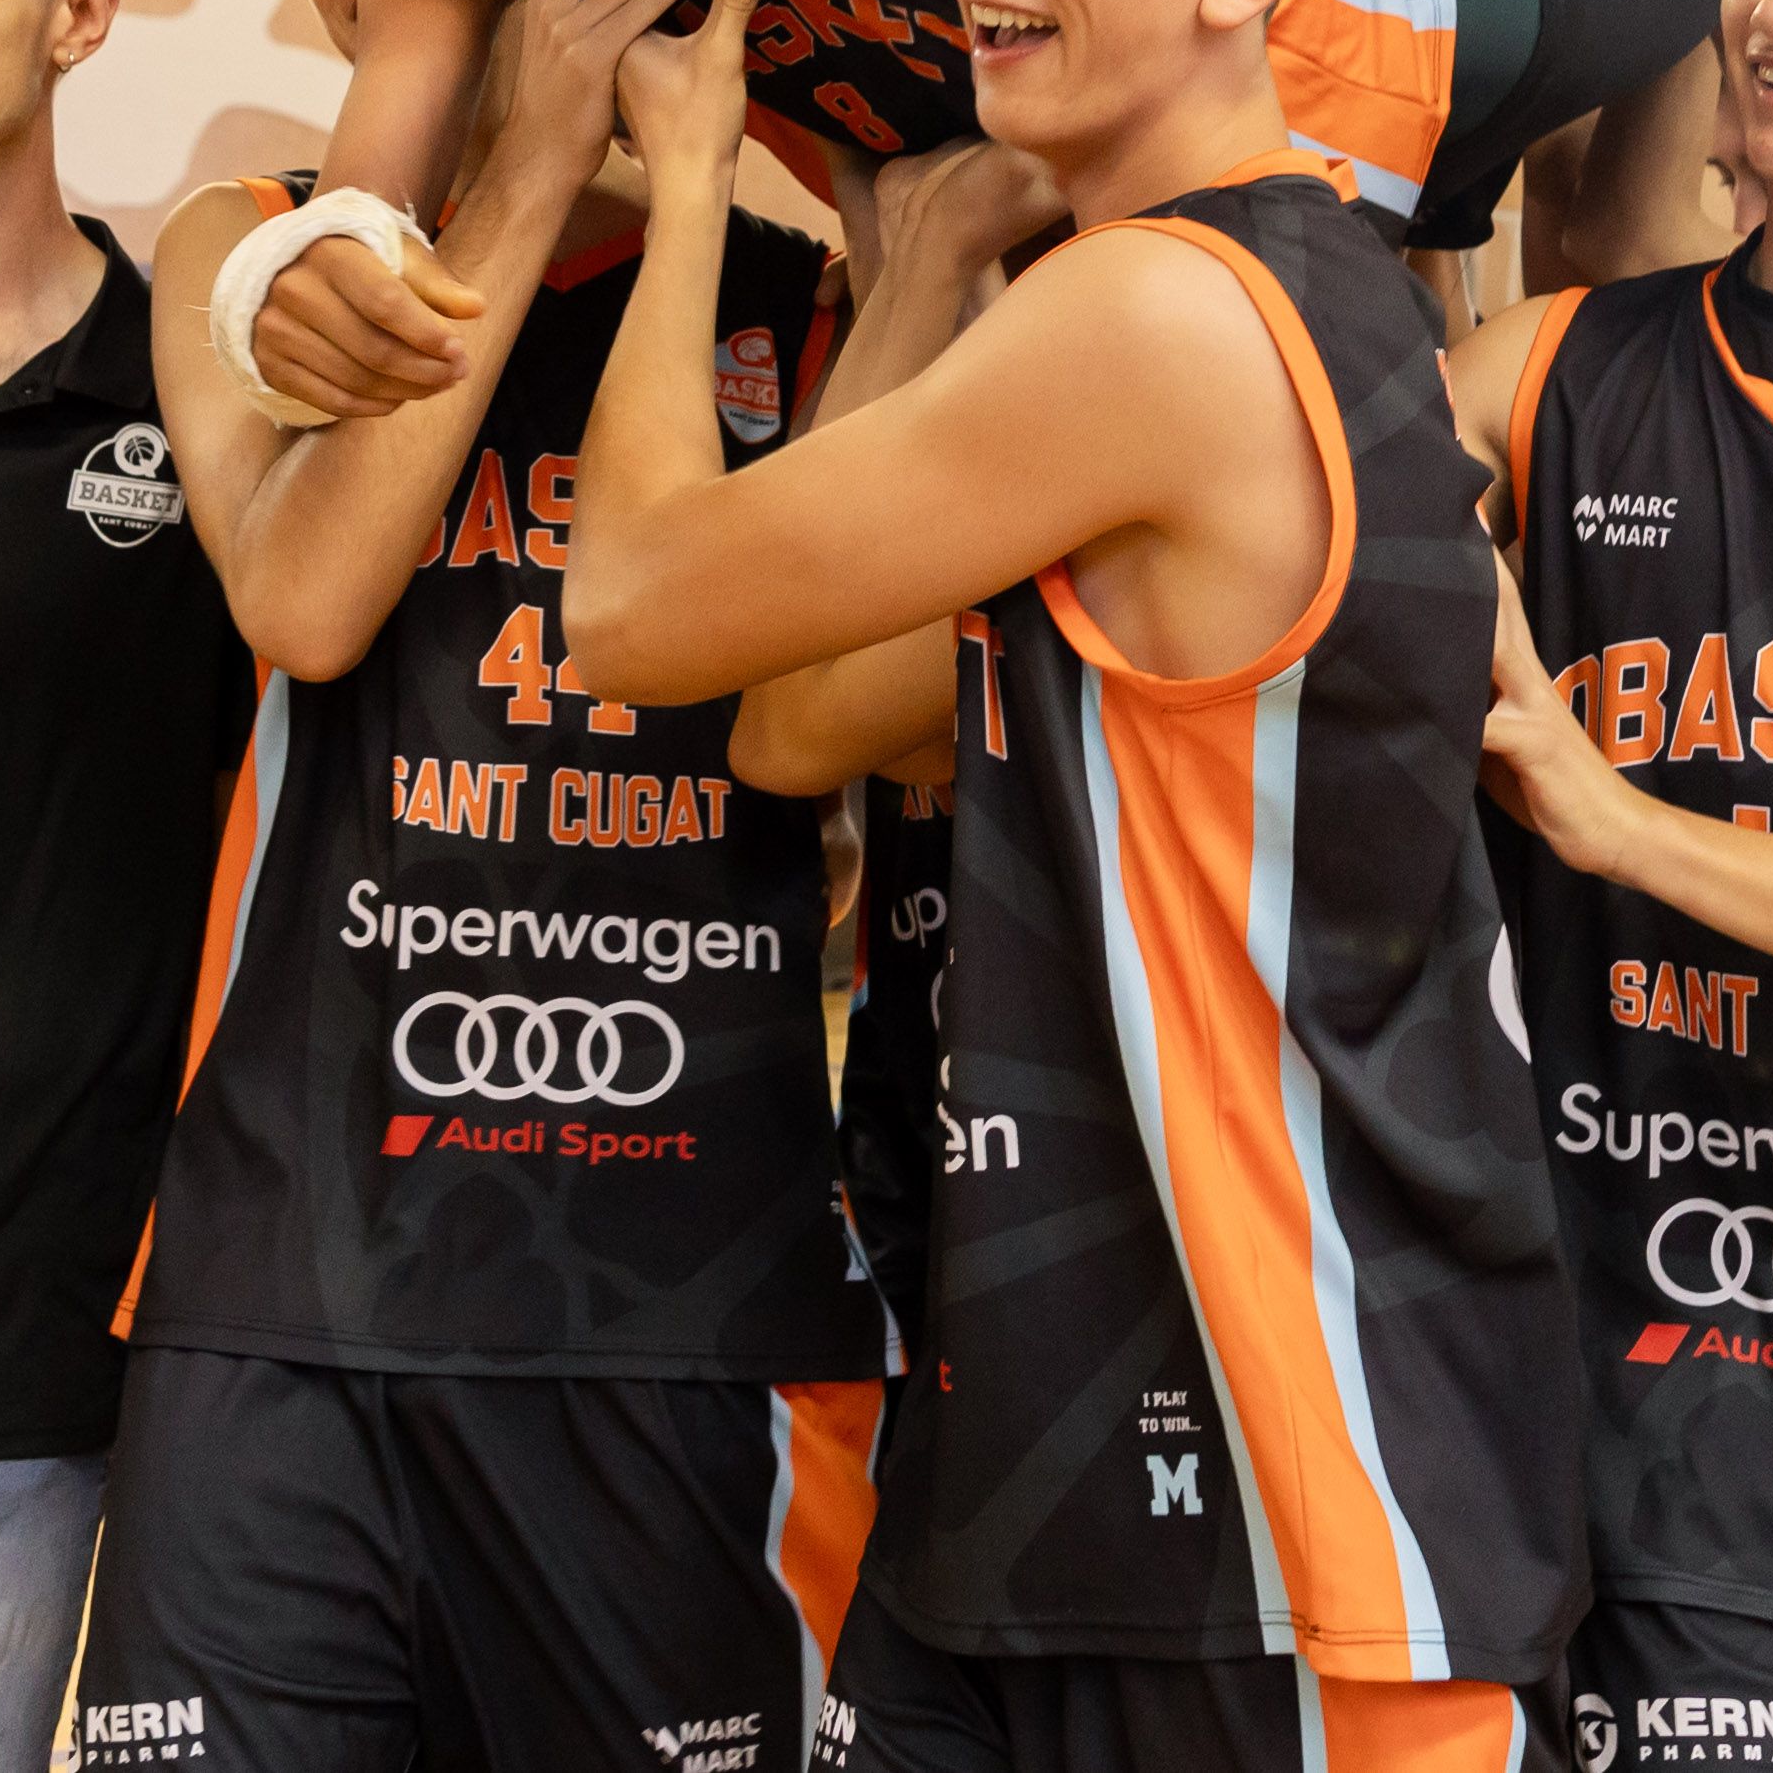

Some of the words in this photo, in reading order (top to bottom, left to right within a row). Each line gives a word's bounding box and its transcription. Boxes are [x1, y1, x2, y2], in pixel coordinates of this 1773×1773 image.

[813, 81, 904, 153] 8
[78, 480, 178, 513] BASKET
[1608, 493, 1679, 519] MARC
[1603, 523, 1672, 548] MART
[548, 766, 732, 849] CUGAT
[1610, 958, 1760, 1058] SANT
[434, 1117, 545, 1154] Audi
[557, 1122, 698, 1166] Sport
[1152, 1390, 1188, 1408] PLAY
[1138, 1417, 1159, 1434] TO
[1145, 1453, 1204, 1516] M
[85, 1696, 205, 1744] KERN
[678, 1713, 763, 1745] MARC
[86, 1741, 206, 1767] PHARMA
